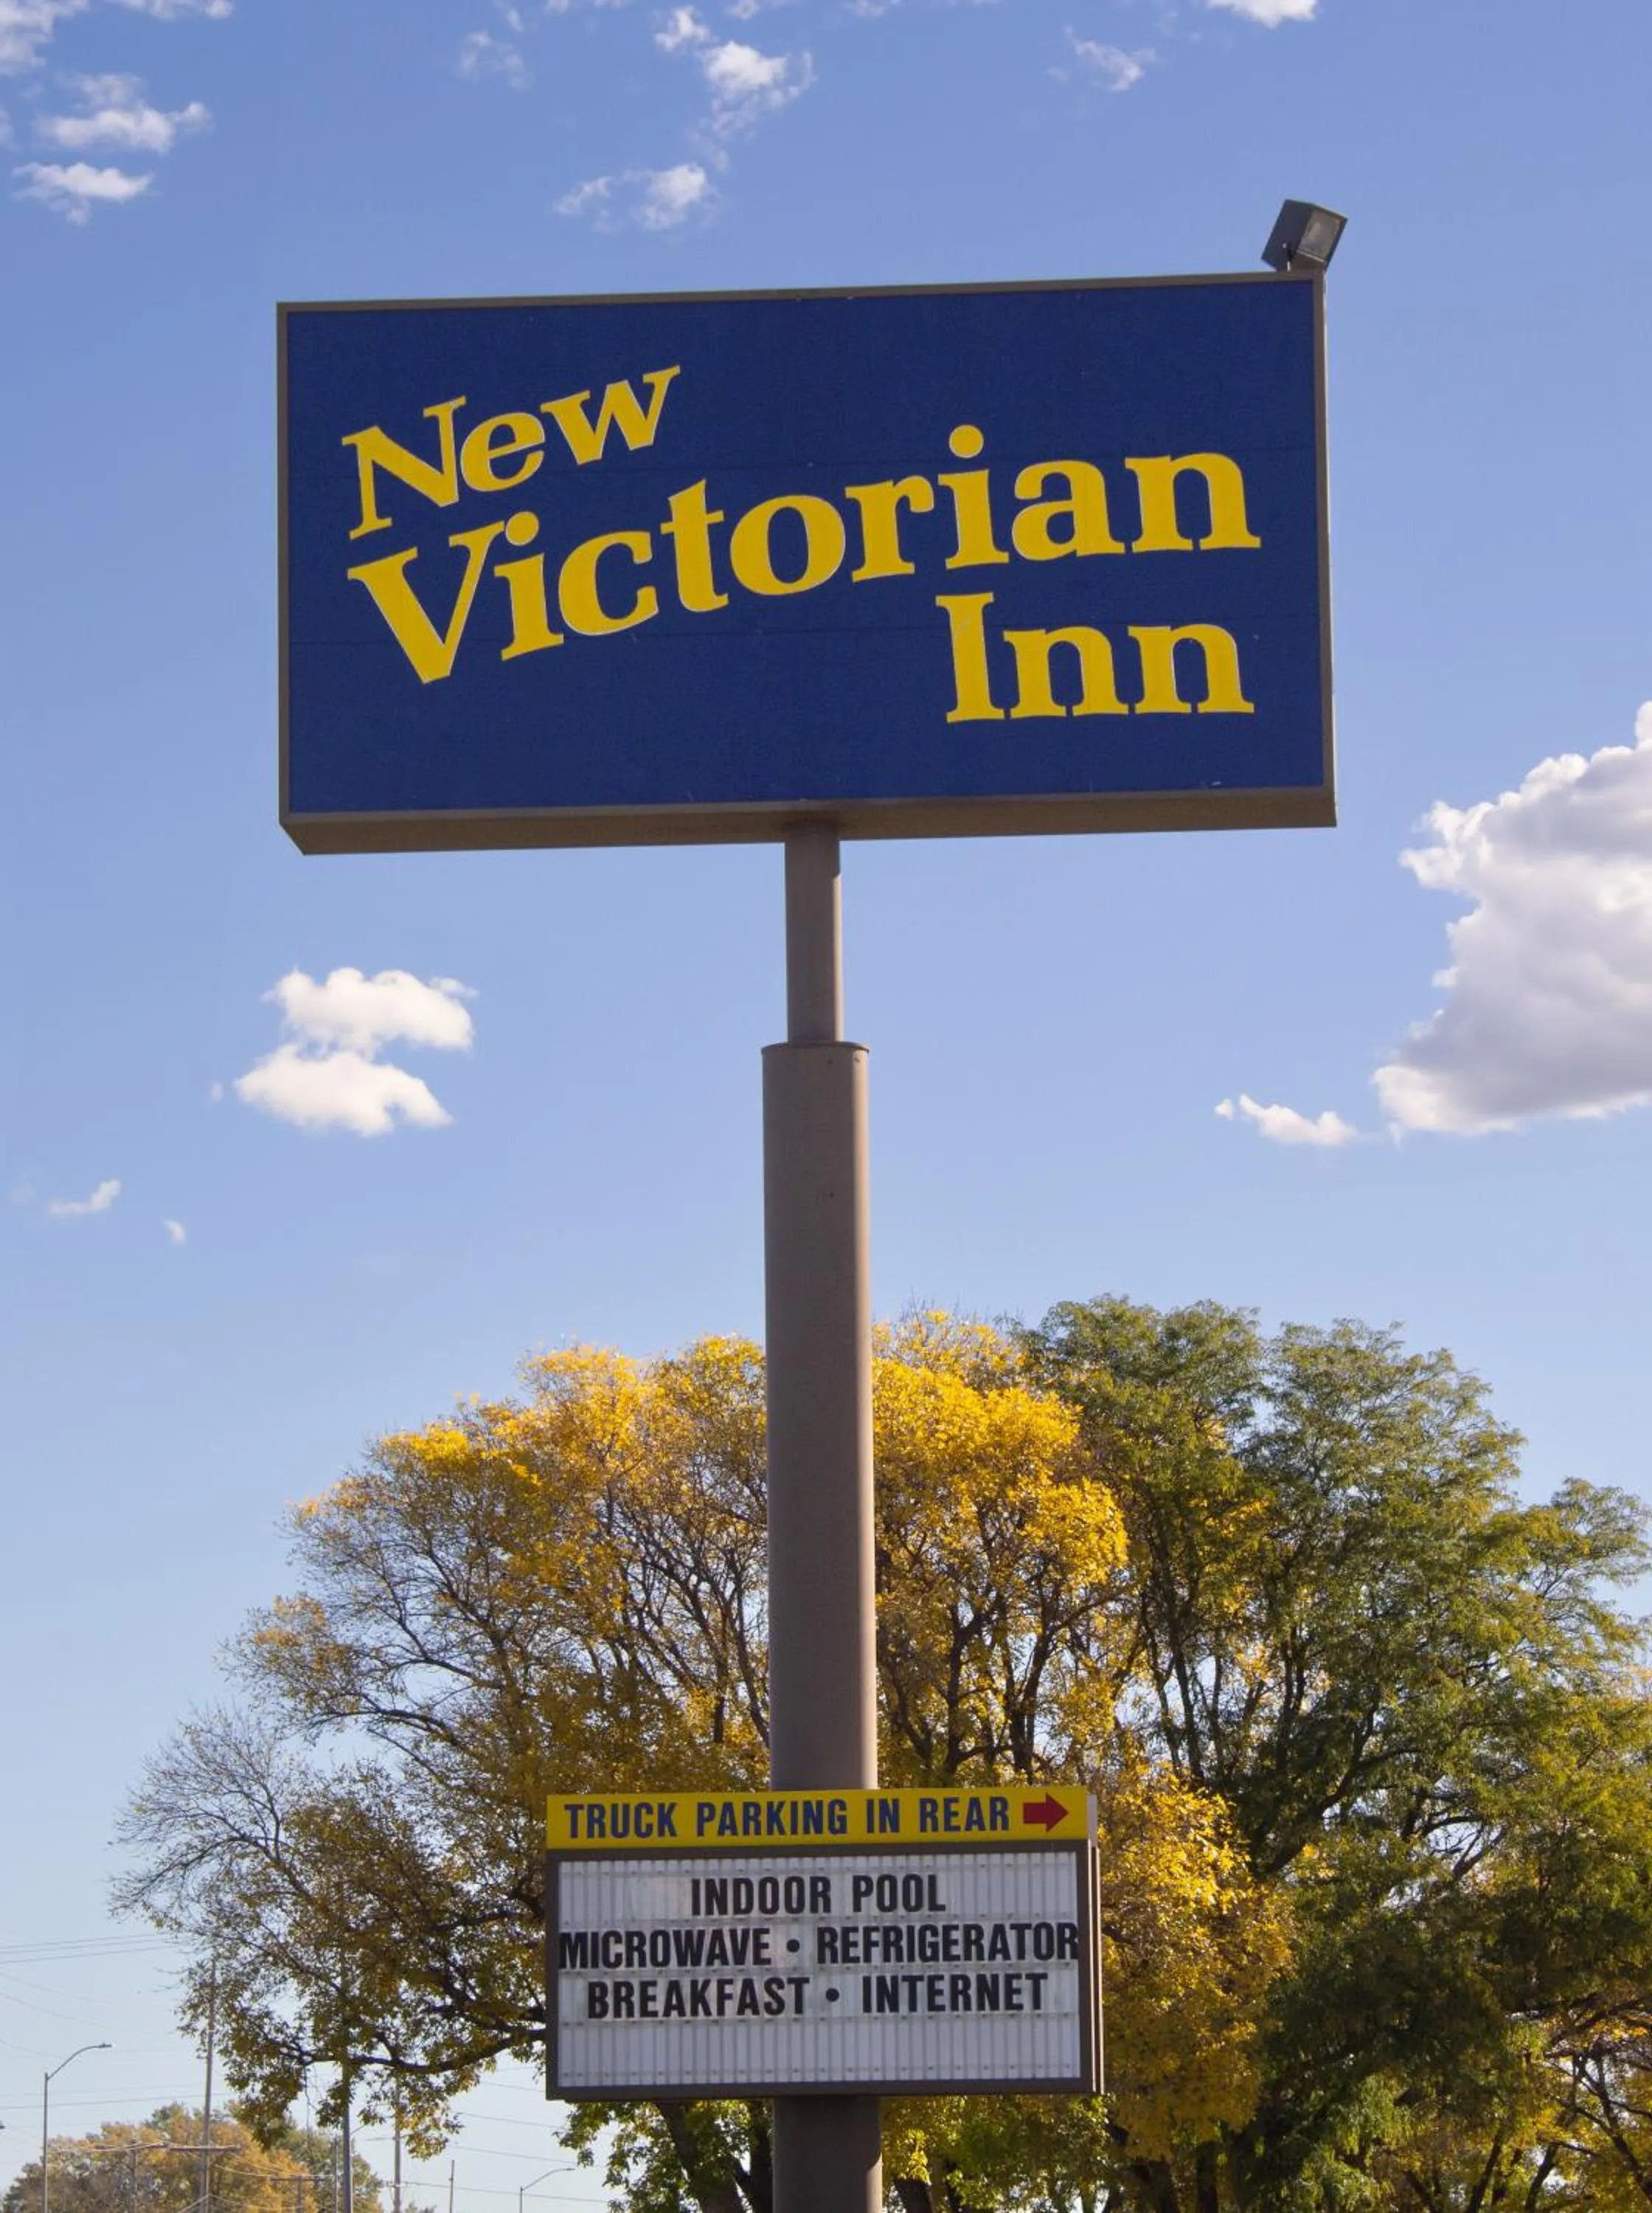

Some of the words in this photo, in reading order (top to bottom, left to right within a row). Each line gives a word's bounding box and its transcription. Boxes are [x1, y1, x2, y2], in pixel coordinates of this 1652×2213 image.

[342, 365, 681, 540] New
[347, 425, 1262, 683] Victorian
[936, 592, 1254, 723] Inn
[565, 1802, 678, 1838] TRUCK
[697, 1798, 847, 1837] PARKING
[866, 1798, 900, 1834] IN
[920, 1796, 1010, 1832] REAR
[691, 1876, 831, 1916] INDOOR
[852, 1874, 945, 1914] POOL
[559, 1928, 771, 1969] MICROWAVE
[817, 1922, 1079, 1964] REFRIGERATOR
[588, 1976, 811, 2019] BREAKFAST
[862, 1973, 1048, 2014] INTERNET
